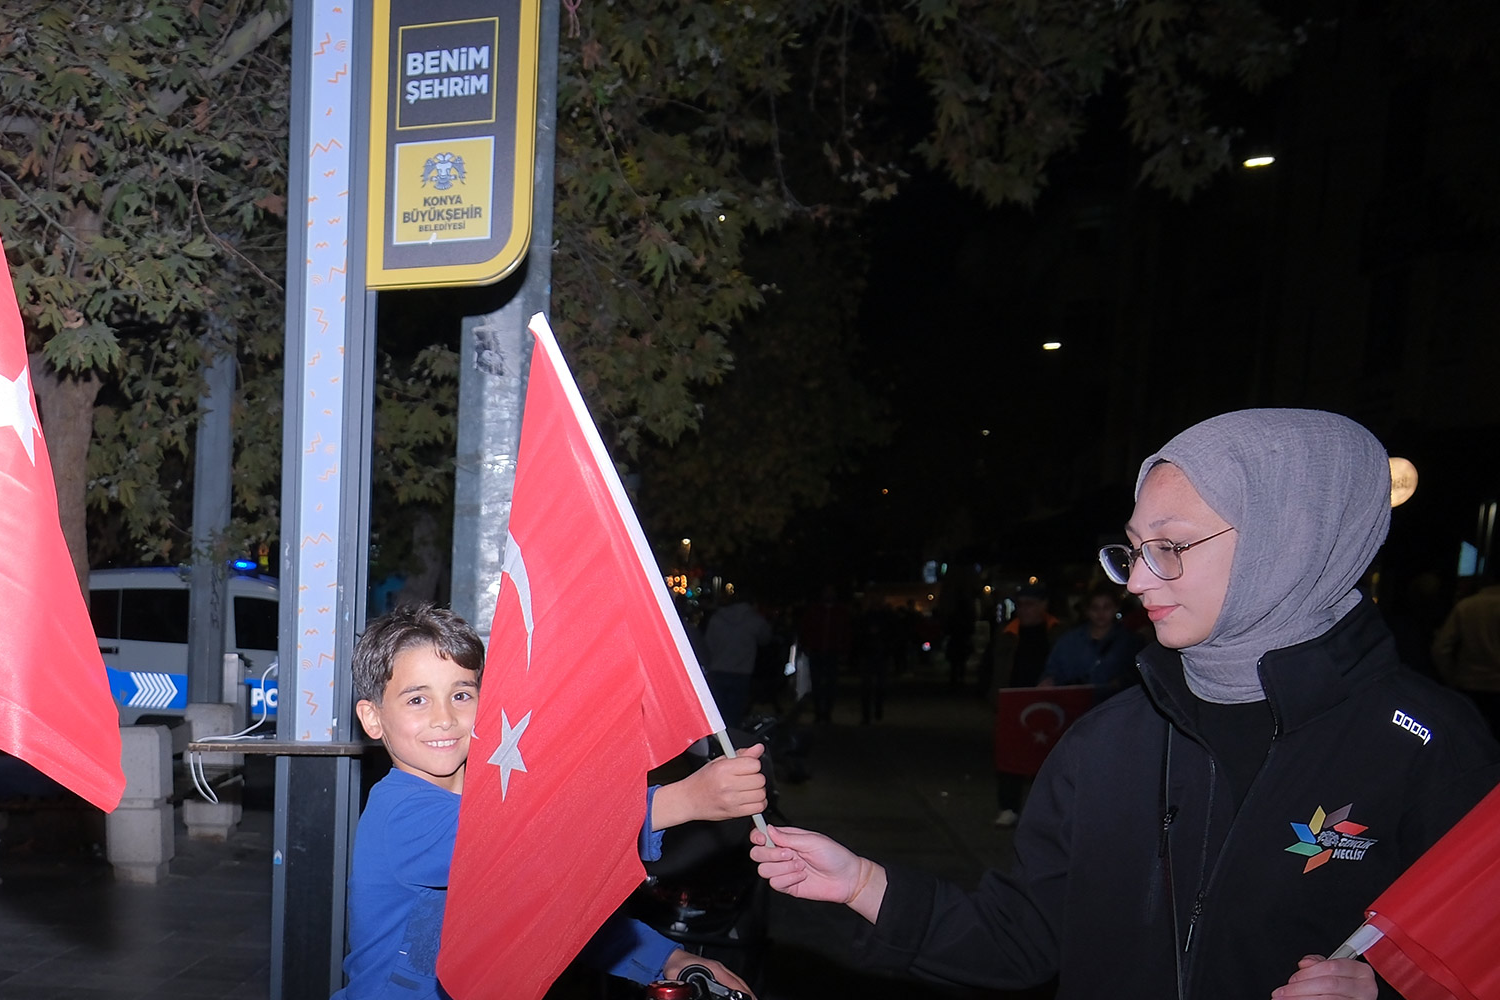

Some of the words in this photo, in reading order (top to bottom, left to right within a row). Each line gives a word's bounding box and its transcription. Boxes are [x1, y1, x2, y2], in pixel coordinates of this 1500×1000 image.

[406, 45, 489, 76] BENİM
[405, 74, 489, 104] ŞEHRİM
[423, 195, 463, 207] KONYA
[403, 204, 482, 223] BÜYÜKŞEHİR
[418, 221, 466, 232] BELEDİYESİ
